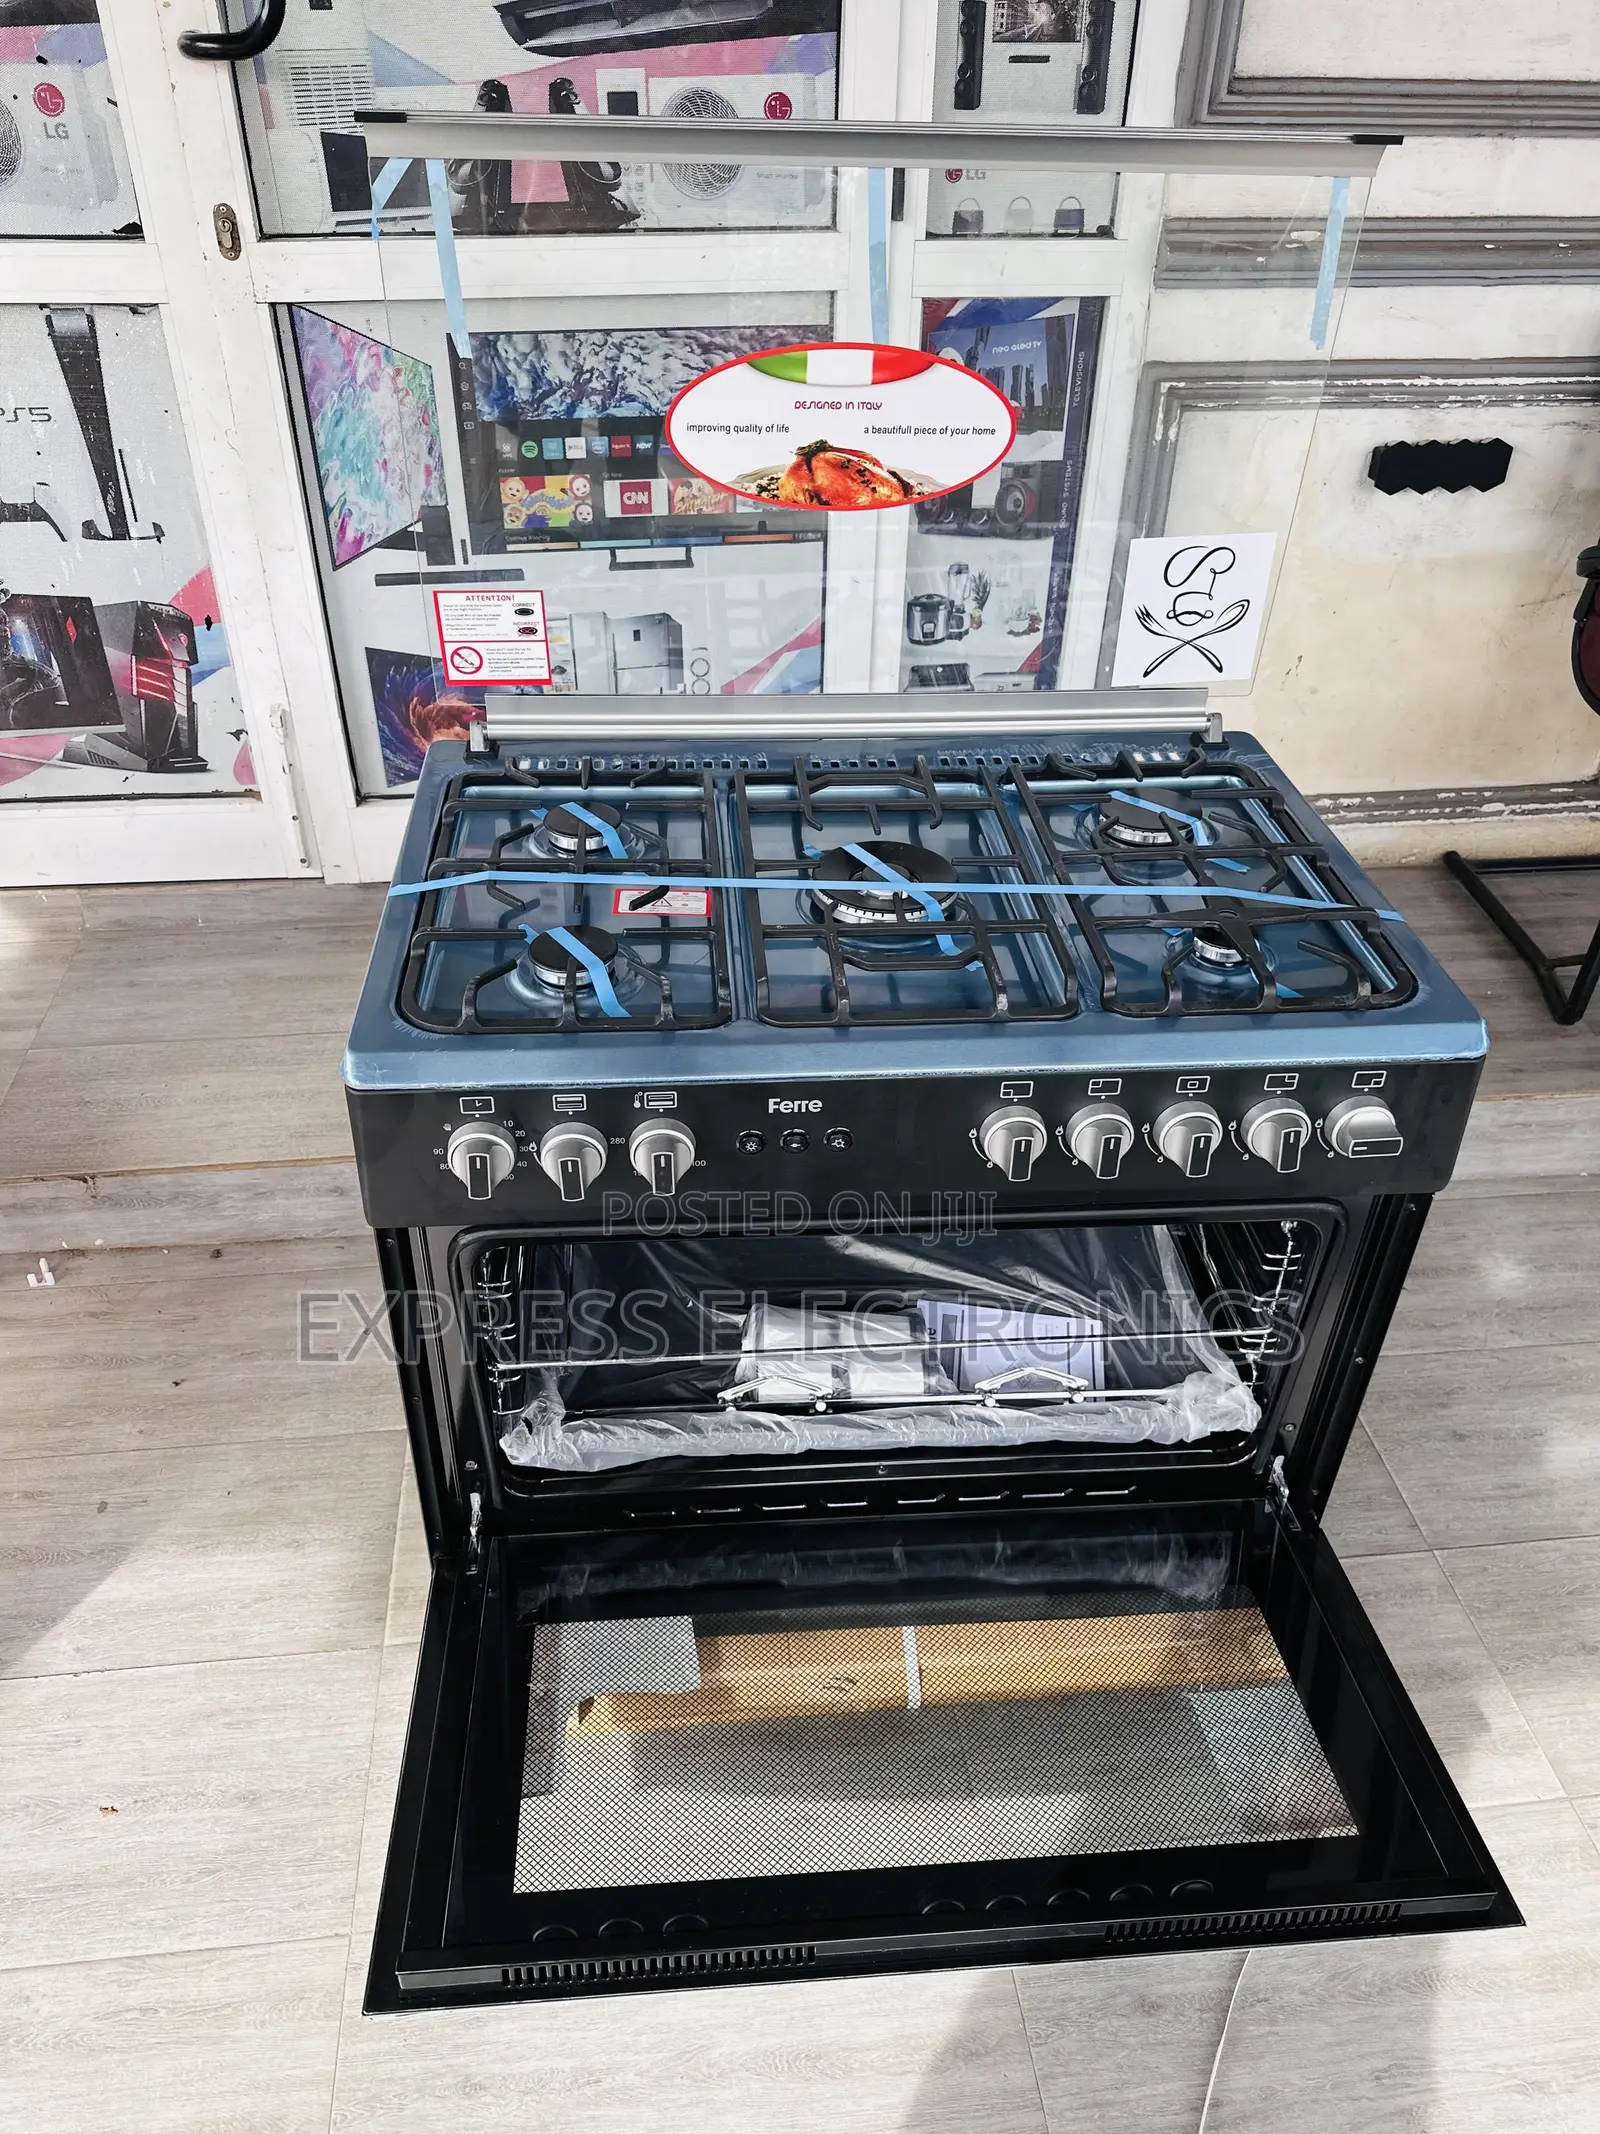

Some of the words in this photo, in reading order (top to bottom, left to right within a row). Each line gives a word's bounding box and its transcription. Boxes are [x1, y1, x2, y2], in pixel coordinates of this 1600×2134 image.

[43, 121, 70, 140] LG
[966, 169, 986, 180] LG
[1072, 351, 1085, 407] TELEVISIONS
[794, 400, 842, 410] DESIGNED
[845, 401, 855, 410] IN
[857, 401, 883, 410] ITALY
[0, 407, 52, 422] S5
[686, 422, 731, 434] improving
[733, 423, 763, 435] quality
[765, 423, 775, 433] of
[776, 424, 790, 433] life
[863, 426, 869, 434] a
[871, 425, 912, 434] beautifull
[914, 426, 937, 436] piece
[939, 425, 949, 435] of
[950, 427, 970, 437] your
[972, 426, 996, 435] home
[1063, 460, 1073, 497] SYSTEMS
[623, 491, 649, 505] CNN
[1059, 501, 1068, 529] SOUND
[465, 594, 515, 602] ATTENTION!
[768, 1097, 823, 1114] Ferre
